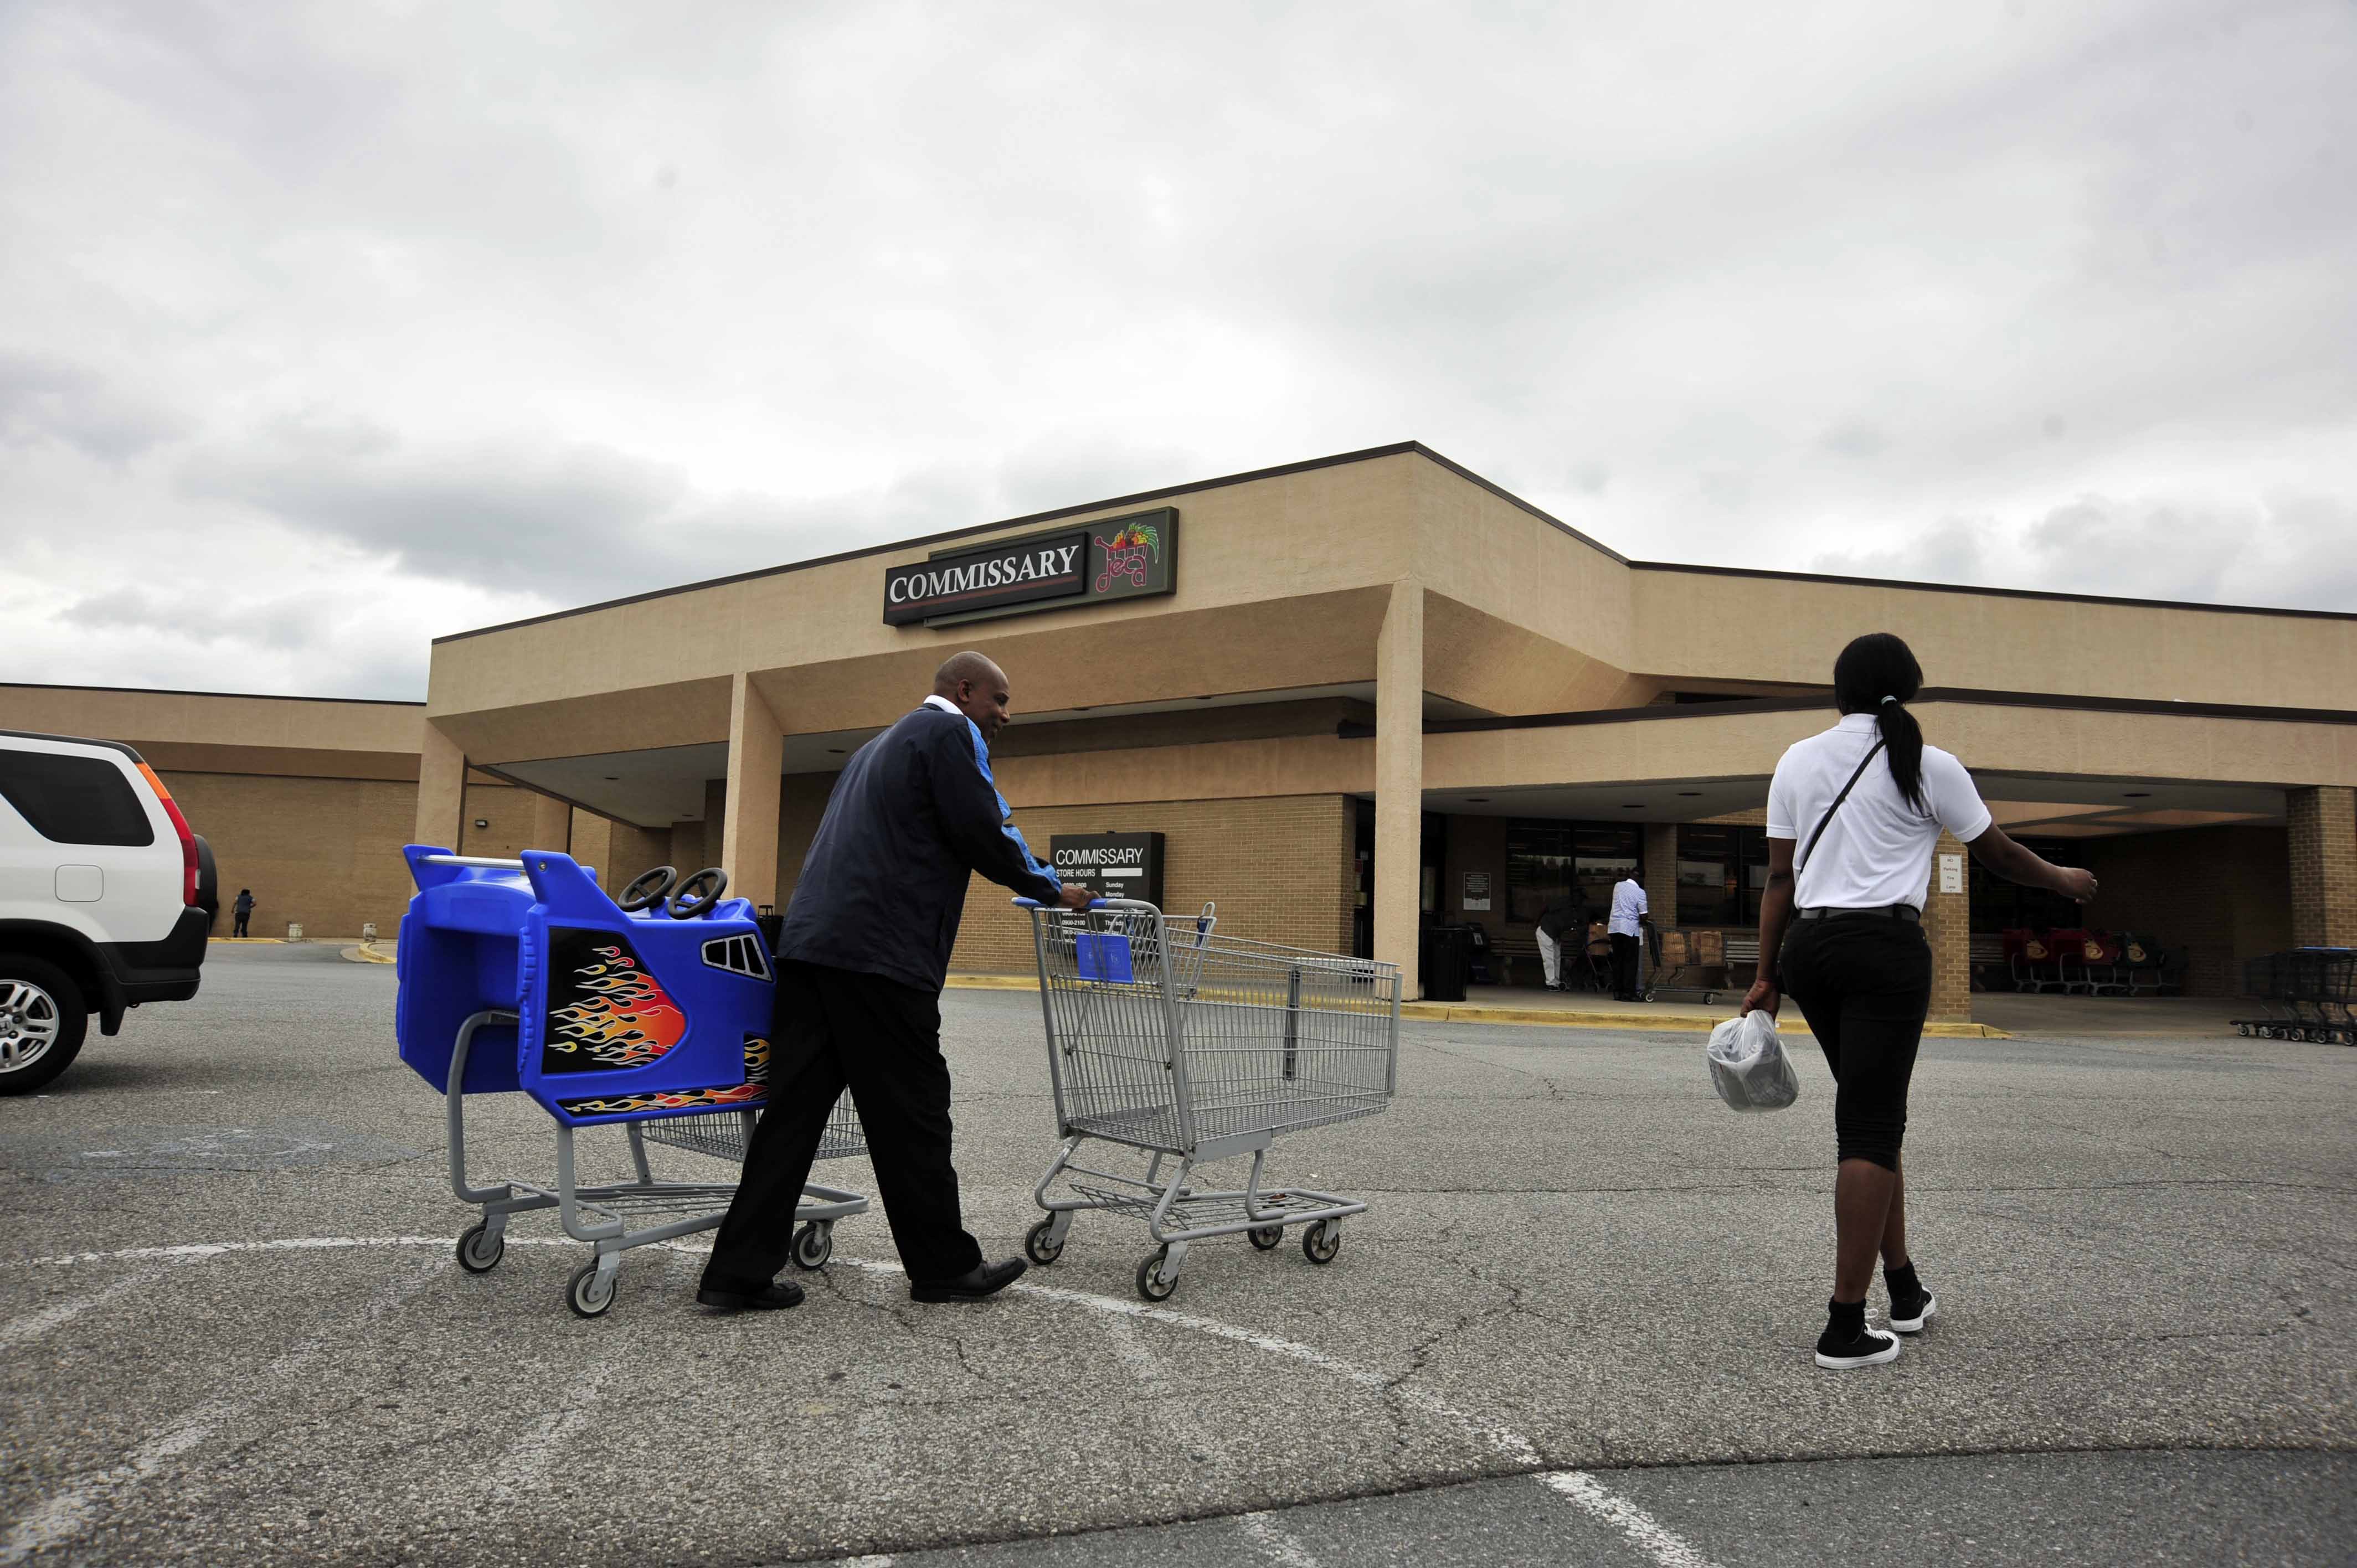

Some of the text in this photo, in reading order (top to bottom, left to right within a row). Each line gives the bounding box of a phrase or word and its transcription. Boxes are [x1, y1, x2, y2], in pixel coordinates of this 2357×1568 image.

[889, 545, 1079, 603] COMMISSARY
[1056, 848, 1144, 865] COMMISSARY
[1056, 868, 1095, 877] STORE HOURS
